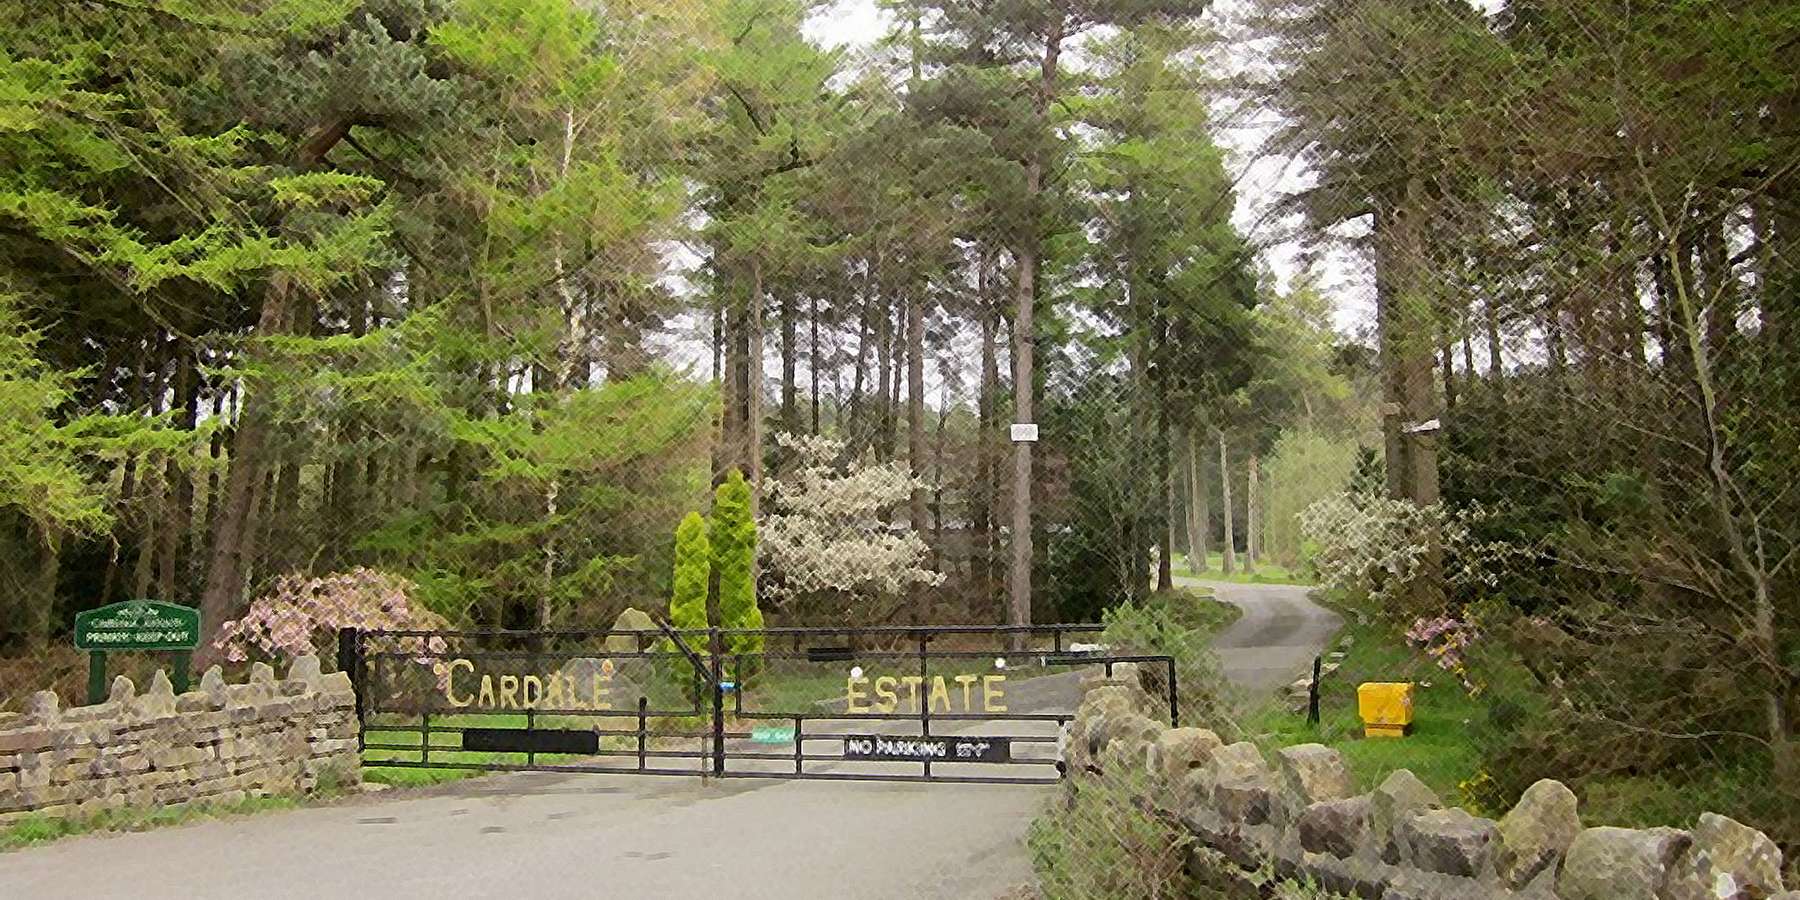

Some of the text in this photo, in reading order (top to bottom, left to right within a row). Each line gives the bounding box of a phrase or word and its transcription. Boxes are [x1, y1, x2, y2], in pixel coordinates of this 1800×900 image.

[446, 658, 1008, 714] CARDALE ESTATE
[848, 738, 873, 755] NO
[875, 737, 947, 757] PARKING
